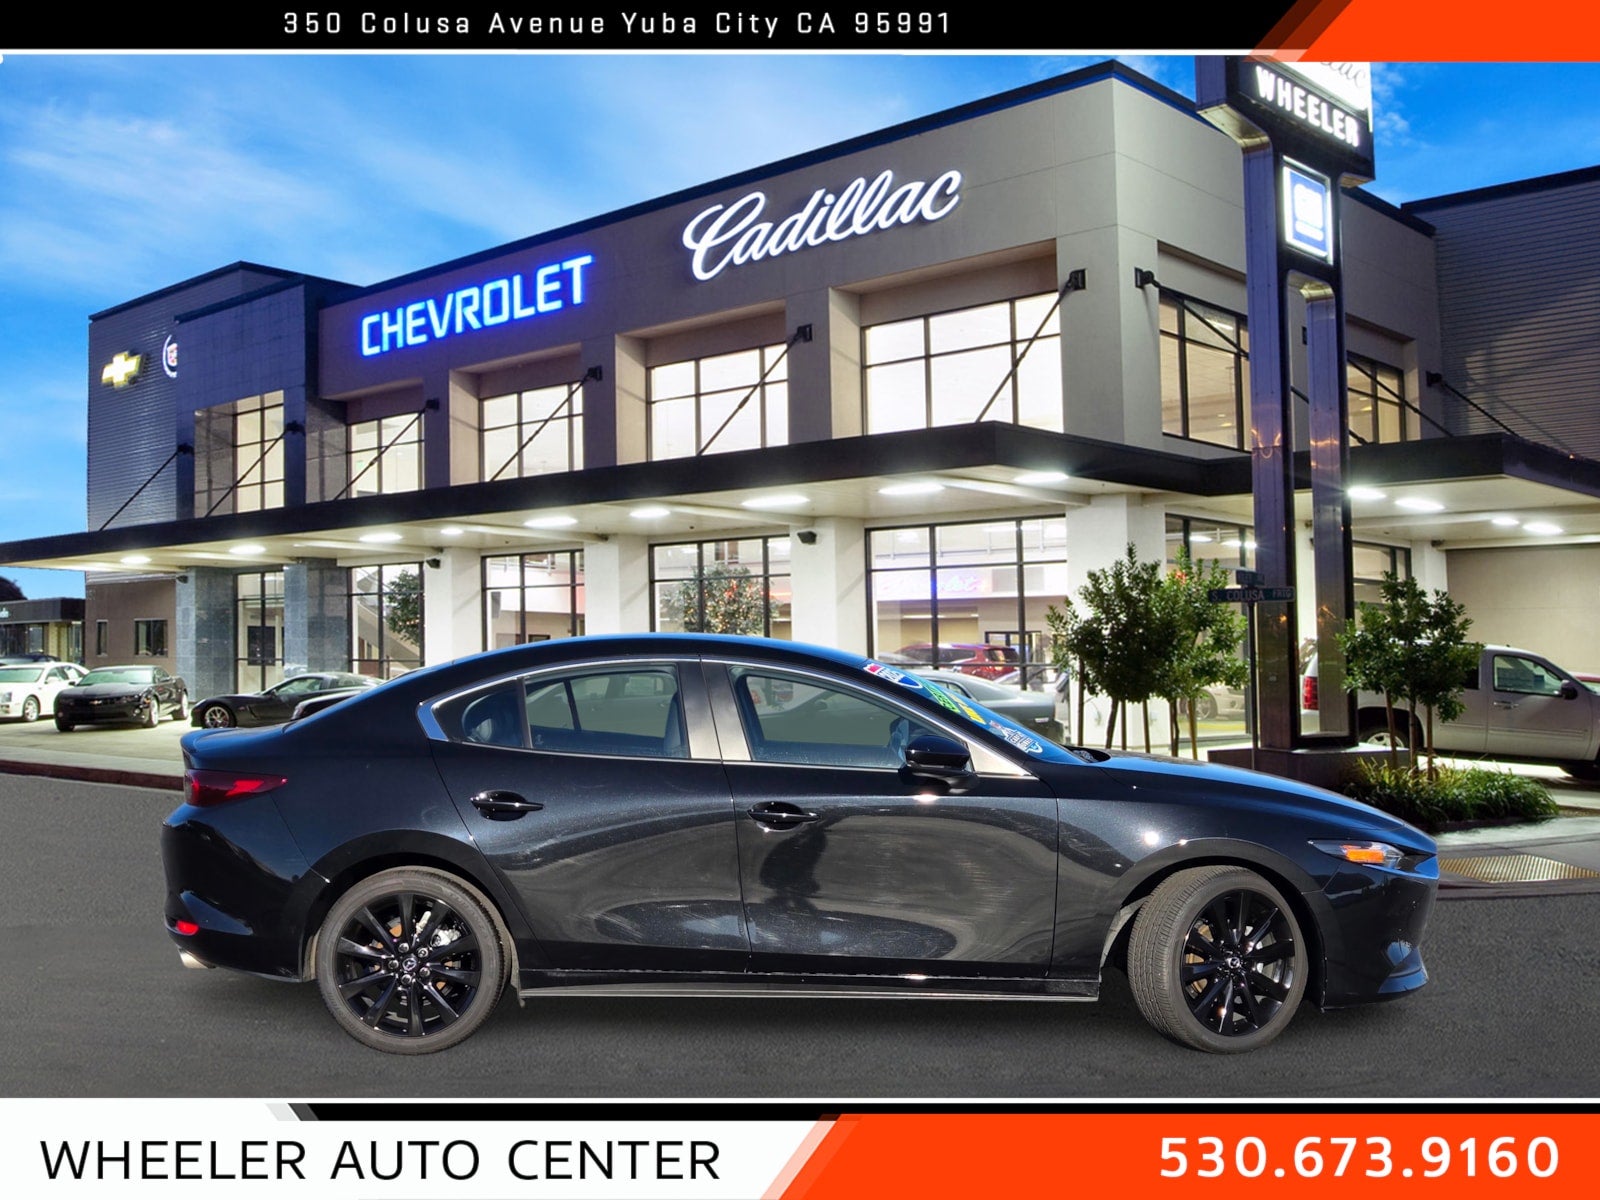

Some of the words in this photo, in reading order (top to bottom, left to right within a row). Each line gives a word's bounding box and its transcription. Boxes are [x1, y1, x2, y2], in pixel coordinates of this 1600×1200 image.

[1255, 65, 1361, 148] WHEELER
[682, 169, 962, 281] Cadillac
[361, 255, 593, 357] CHEVROLET
[1226, 589, 1265, 602] COLUSA
